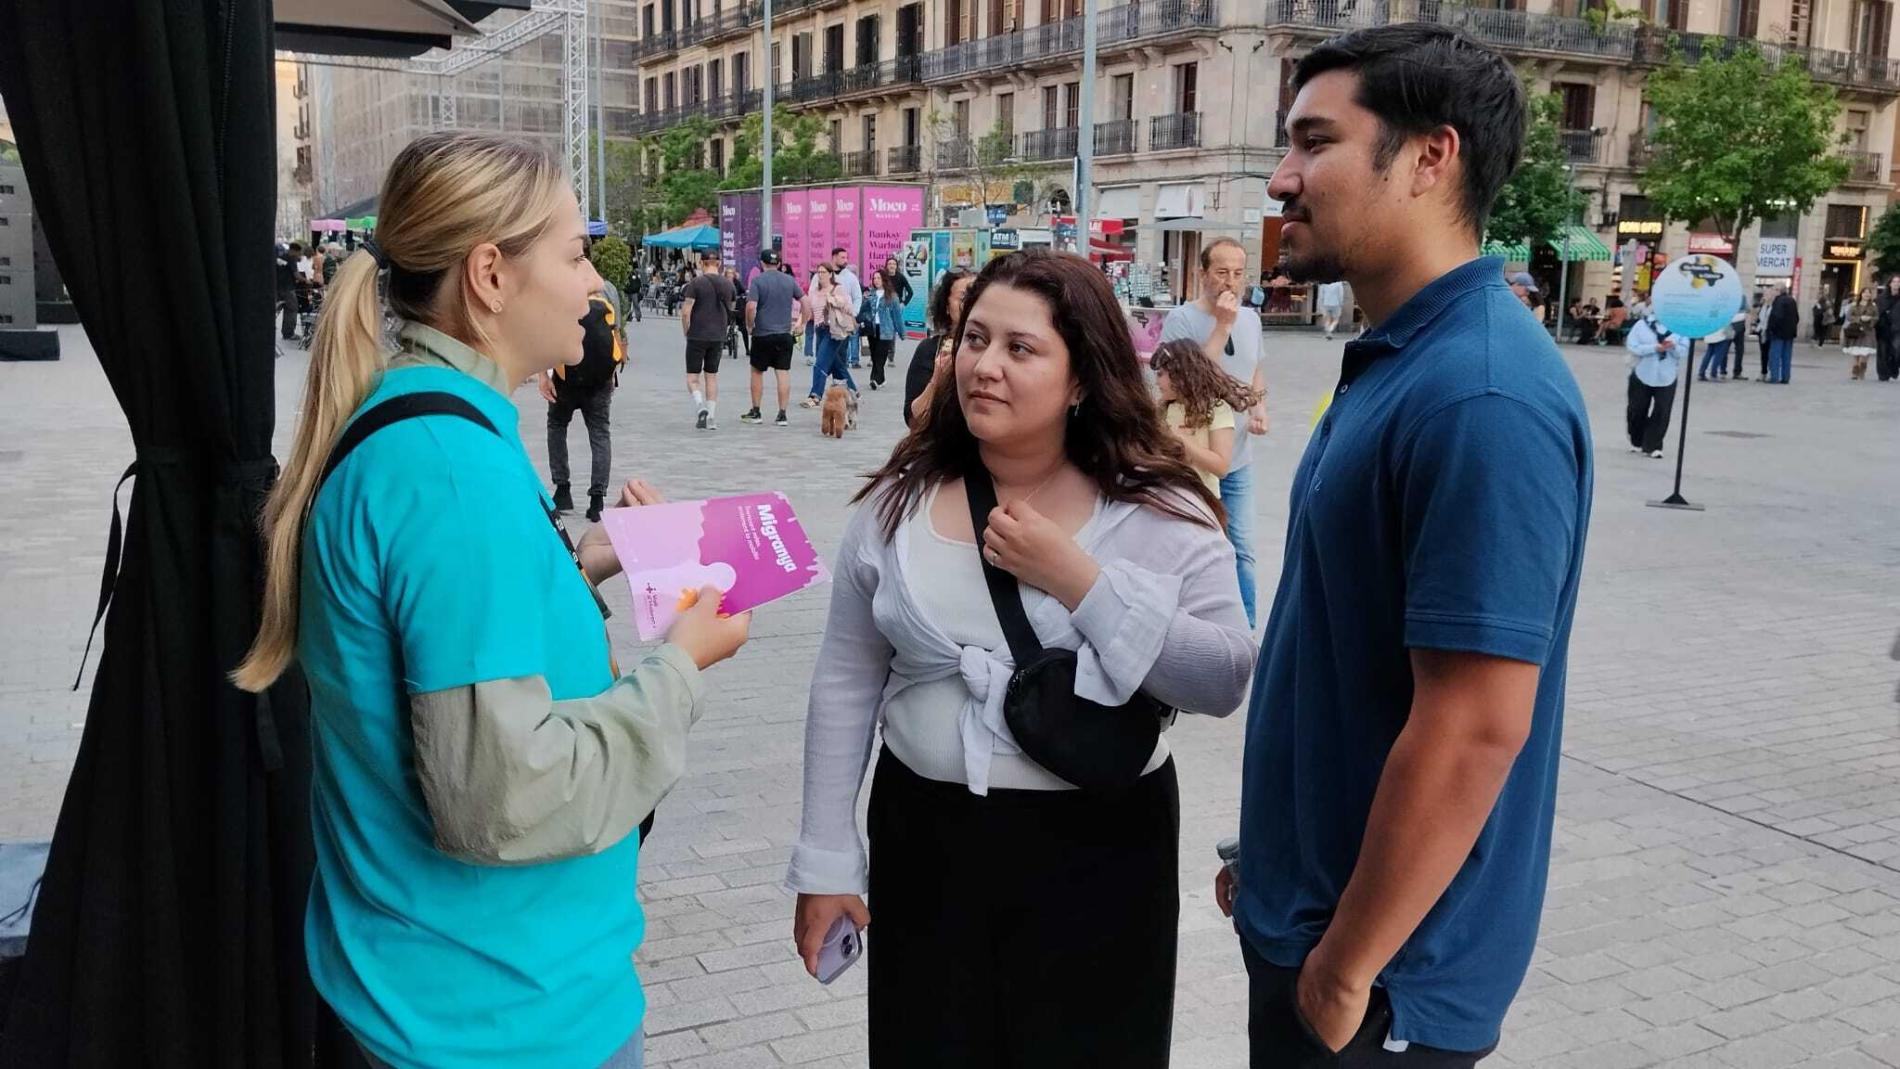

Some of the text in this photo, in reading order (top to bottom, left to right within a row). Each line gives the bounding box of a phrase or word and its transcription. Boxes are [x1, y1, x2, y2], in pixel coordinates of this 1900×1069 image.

[869, 199, 907, 211] Moco
[869, 229, 901, 241] Banksy
[993, 232, 1010, 240] ATM
[869, 241, 902, 249] Warhol
[1760, 244, 1787, 254] SUPER
[757, 504, 797, 573] Migranya
